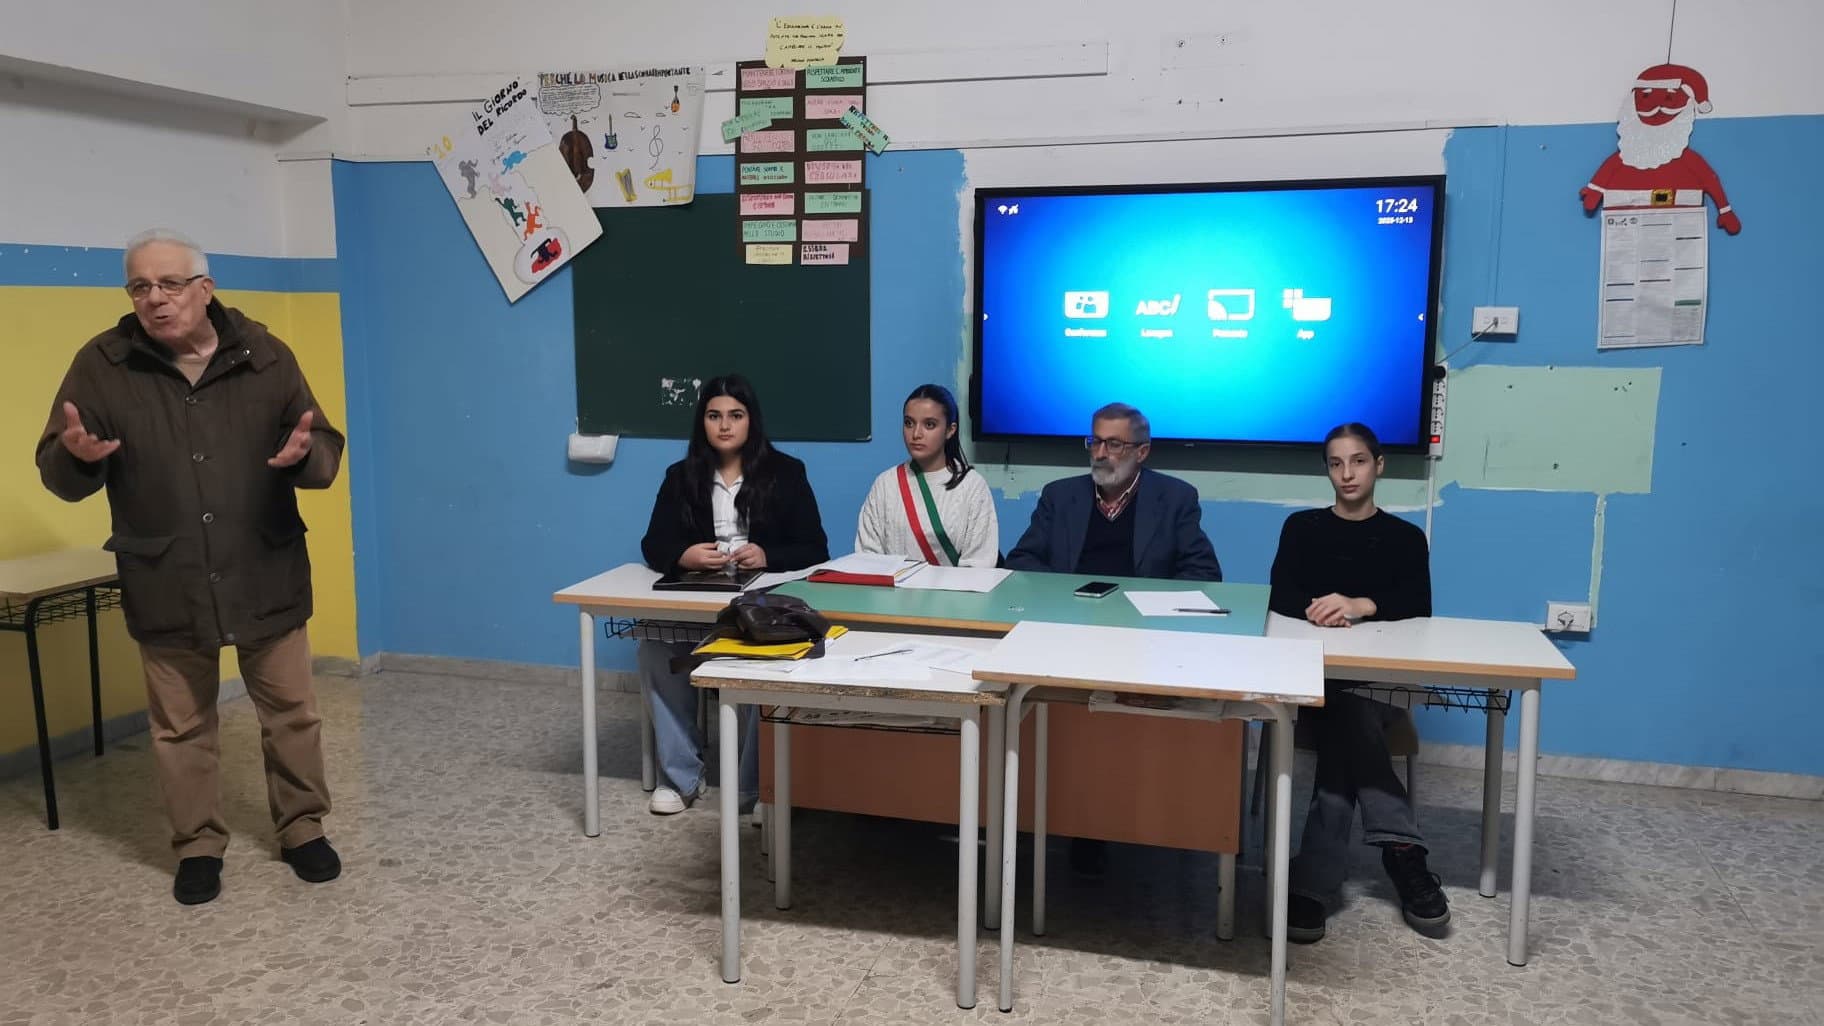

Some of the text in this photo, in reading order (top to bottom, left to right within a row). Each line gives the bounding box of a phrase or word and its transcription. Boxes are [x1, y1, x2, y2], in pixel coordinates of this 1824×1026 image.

[589, 72, 616, 84] MUSICA
[472, 111, 483, 121] IL
[483, 80, 519, 113] GIORNO
[477, 118, 494, 136] DEL
[496, 88, 527, 117] RICORDO
[1376, 198, 1418, 213] 17:24
